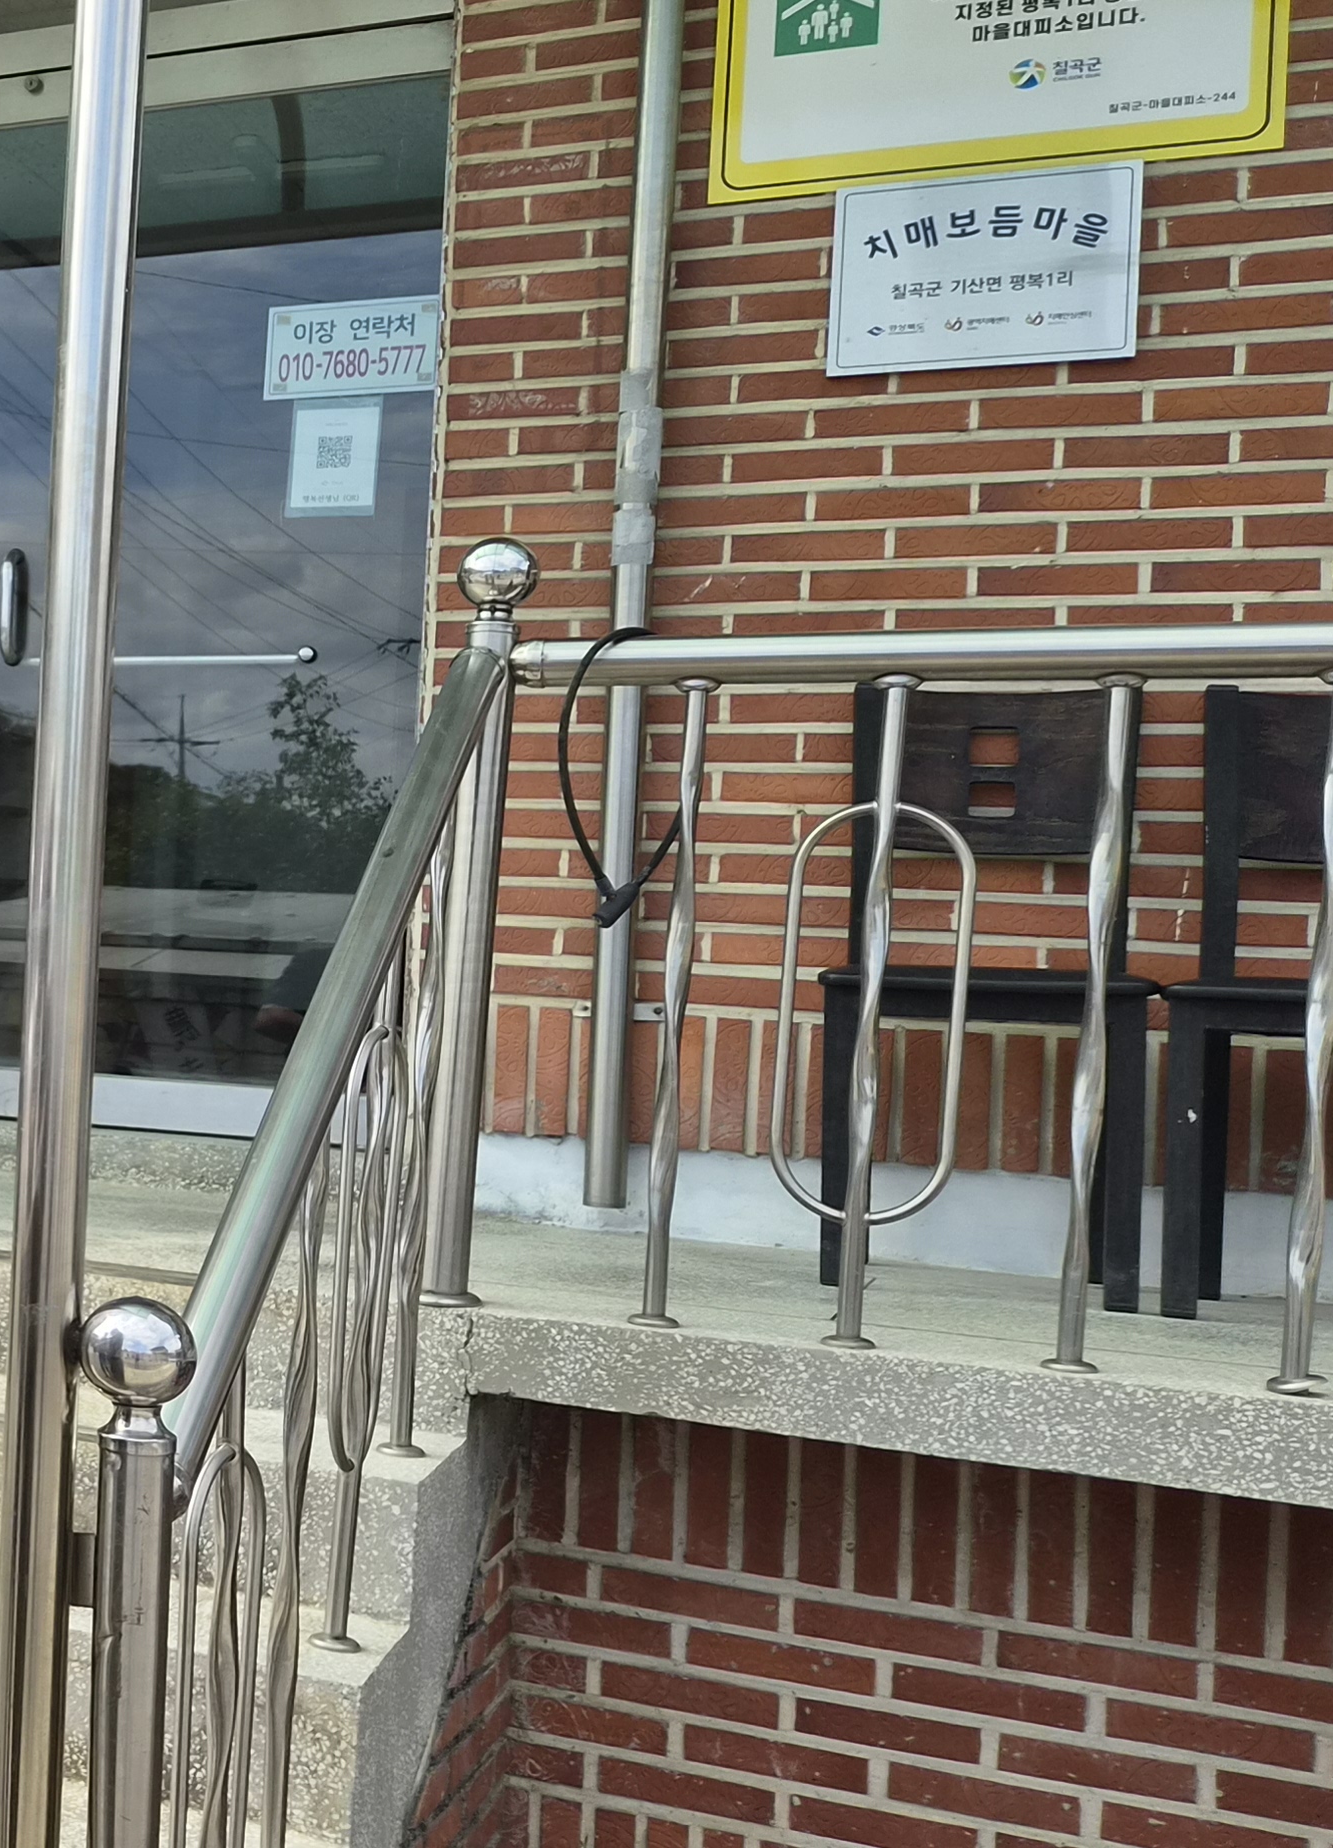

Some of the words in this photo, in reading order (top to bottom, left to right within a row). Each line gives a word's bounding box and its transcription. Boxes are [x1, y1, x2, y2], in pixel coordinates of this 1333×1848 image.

[955, 0, 1014, 20] 지정된
[971, 7, 1146, 42] 마을대피소입니다.
[1053, 57, 1102, 76] 칠곡군
[863, 205, 1109, 259] 치매보듬마을
[890, 281, 943, 301] 칠곡군
[950, 275, 1002, 296] 기산면
[1009, 270, 1074, 291] 평복1리
[294, 320, 336, 344] 이장
[350, 313, 416, 340] 연락처
[278, 344, 427, 382] 010-7680-5777
